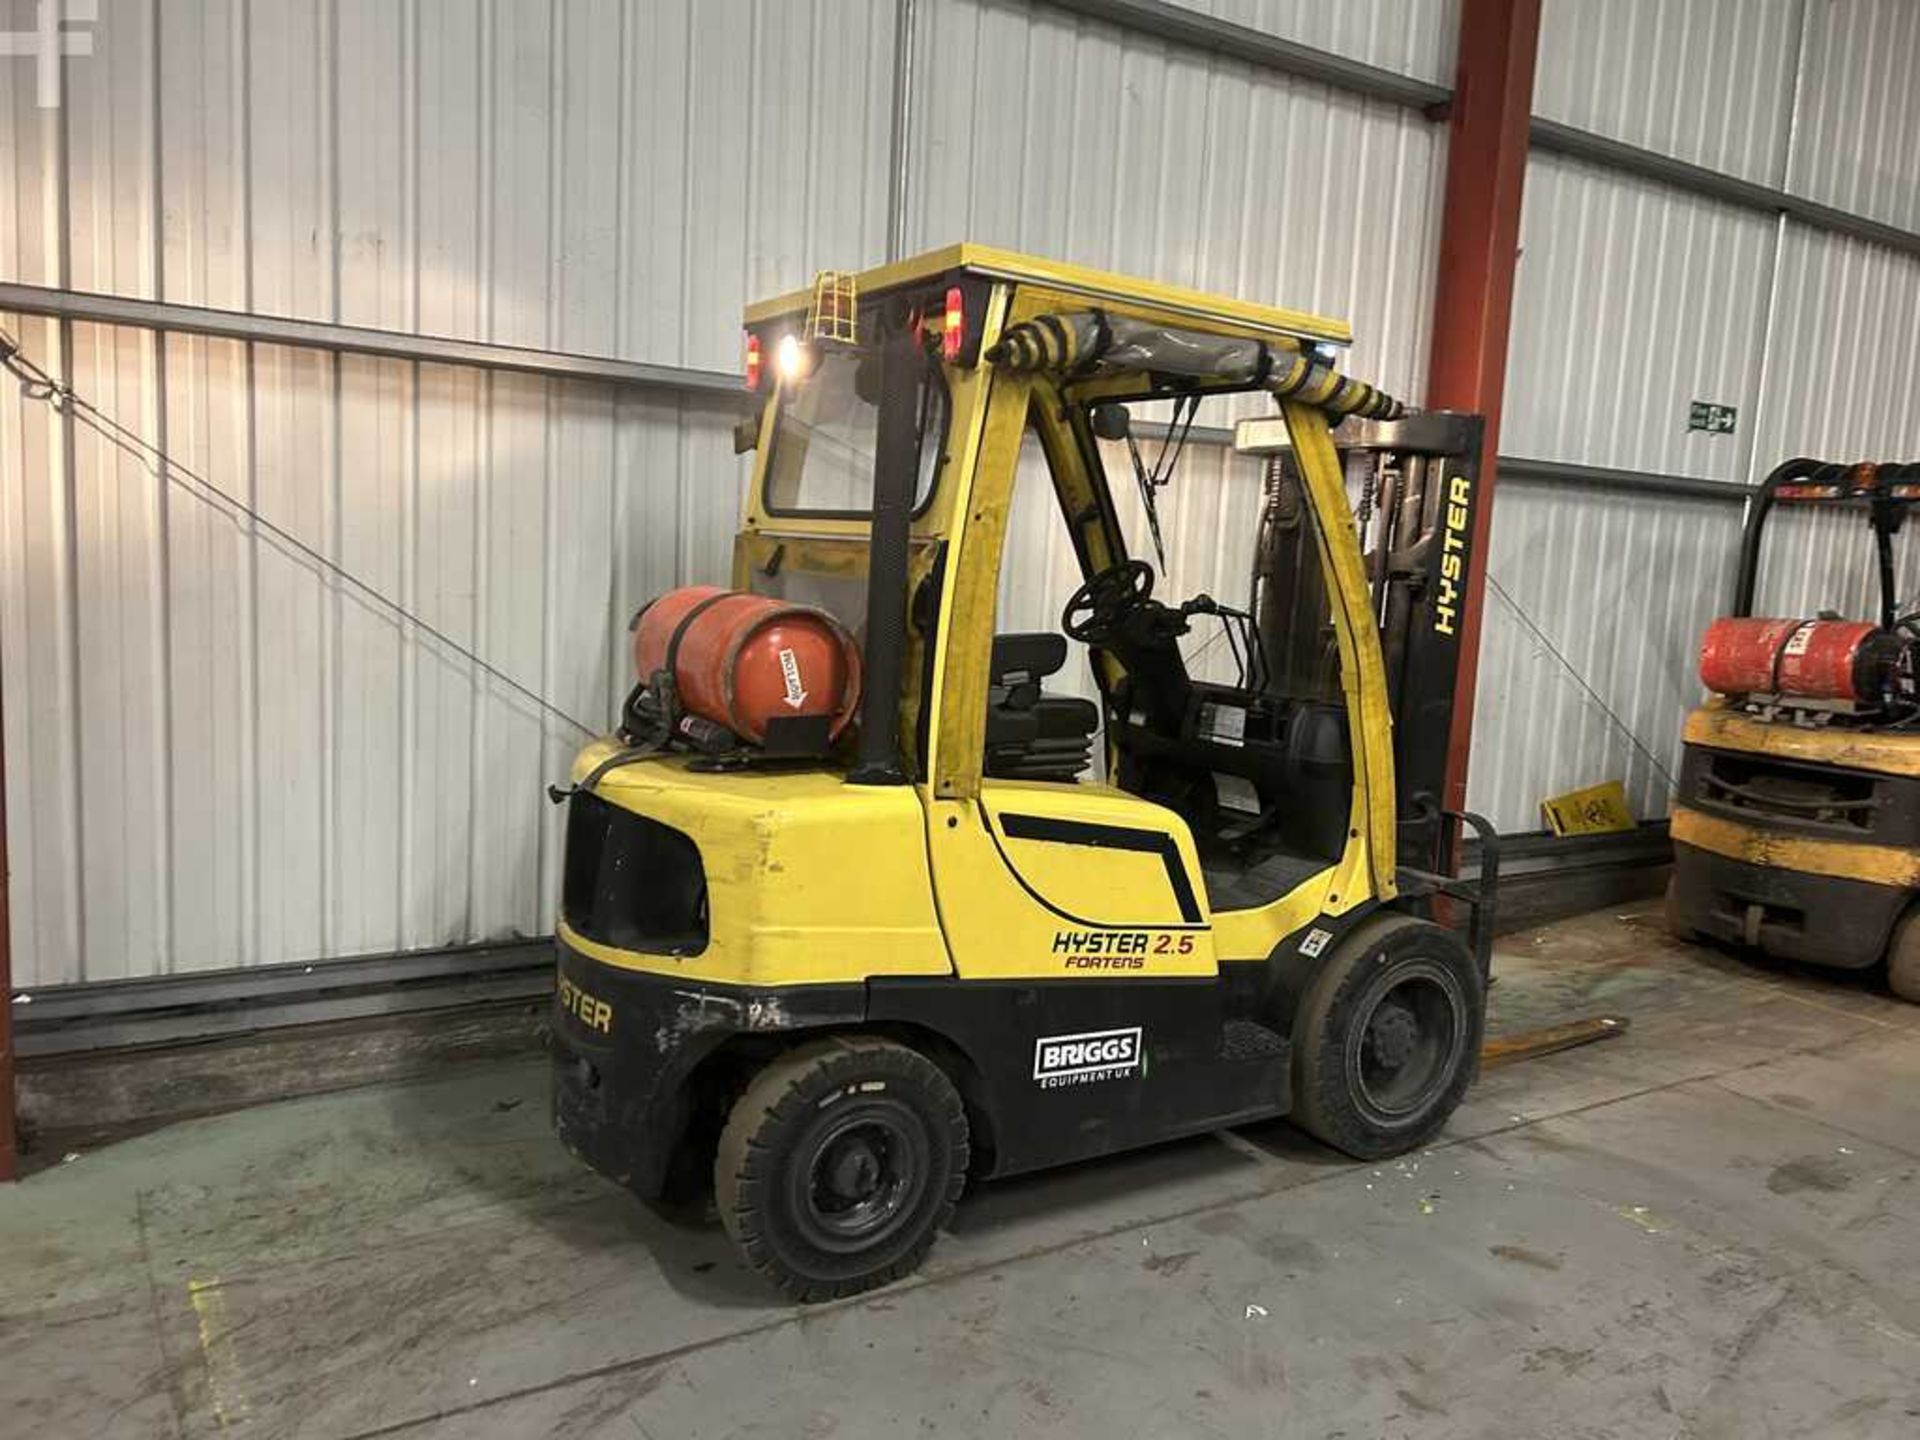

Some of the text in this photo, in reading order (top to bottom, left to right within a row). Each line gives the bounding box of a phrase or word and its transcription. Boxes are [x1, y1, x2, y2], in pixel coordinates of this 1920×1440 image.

[1434, 476, 1471, 636] HYSTER
[1052, 931, 1196, 955] HYSTER 2.5
[1064, 955, 1145, 969] FORTENS
[560, 975, 613, 1034] STER
[1043, 1037, 1133, 1069] BRIGGS
[1040, 1067, 1131, 1090] EQUIPMENT UK
